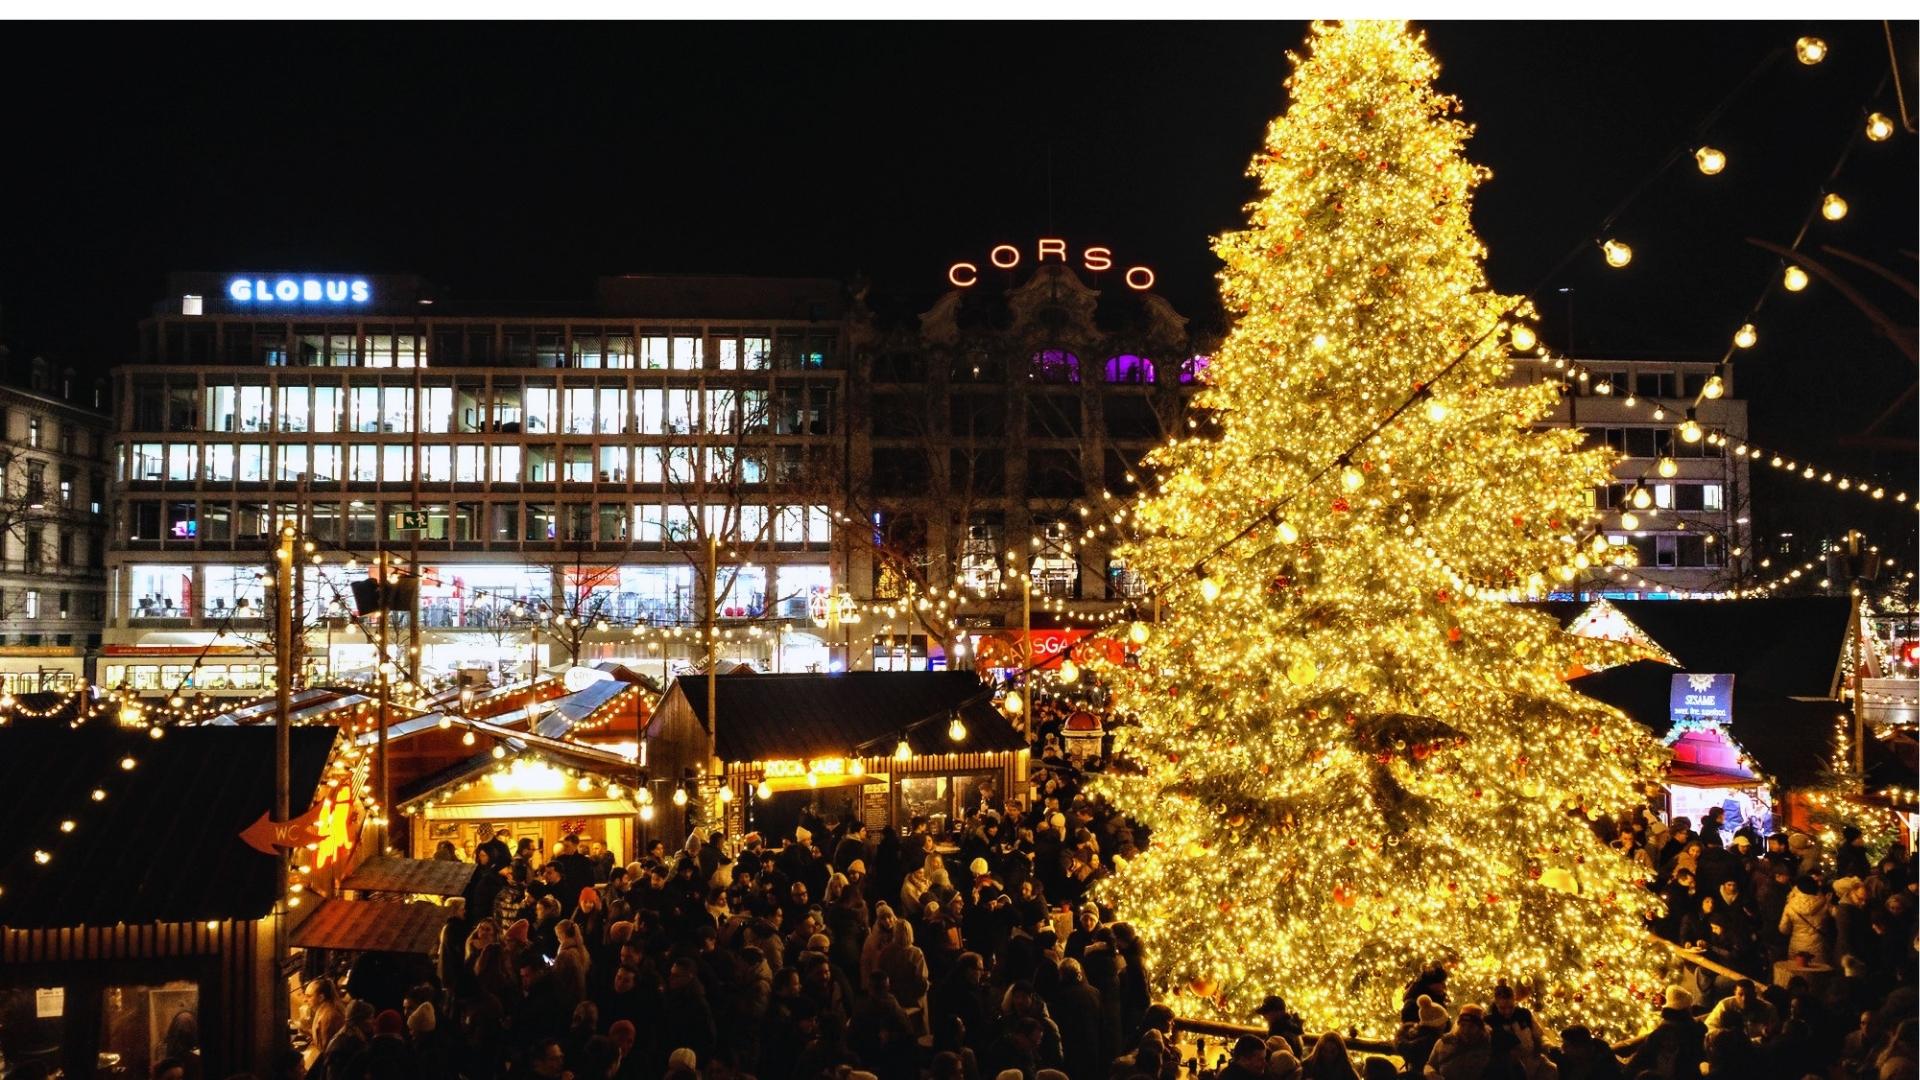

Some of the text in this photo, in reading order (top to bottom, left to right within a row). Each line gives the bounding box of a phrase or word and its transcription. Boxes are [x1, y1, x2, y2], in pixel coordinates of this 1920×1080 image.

[949, 238, 1155, 290] CORSO
[229, 278, 369, 302] GLOBUS
[1684, 694, 1716, 706] SESAME
[275, 824, 300, 841] WC
